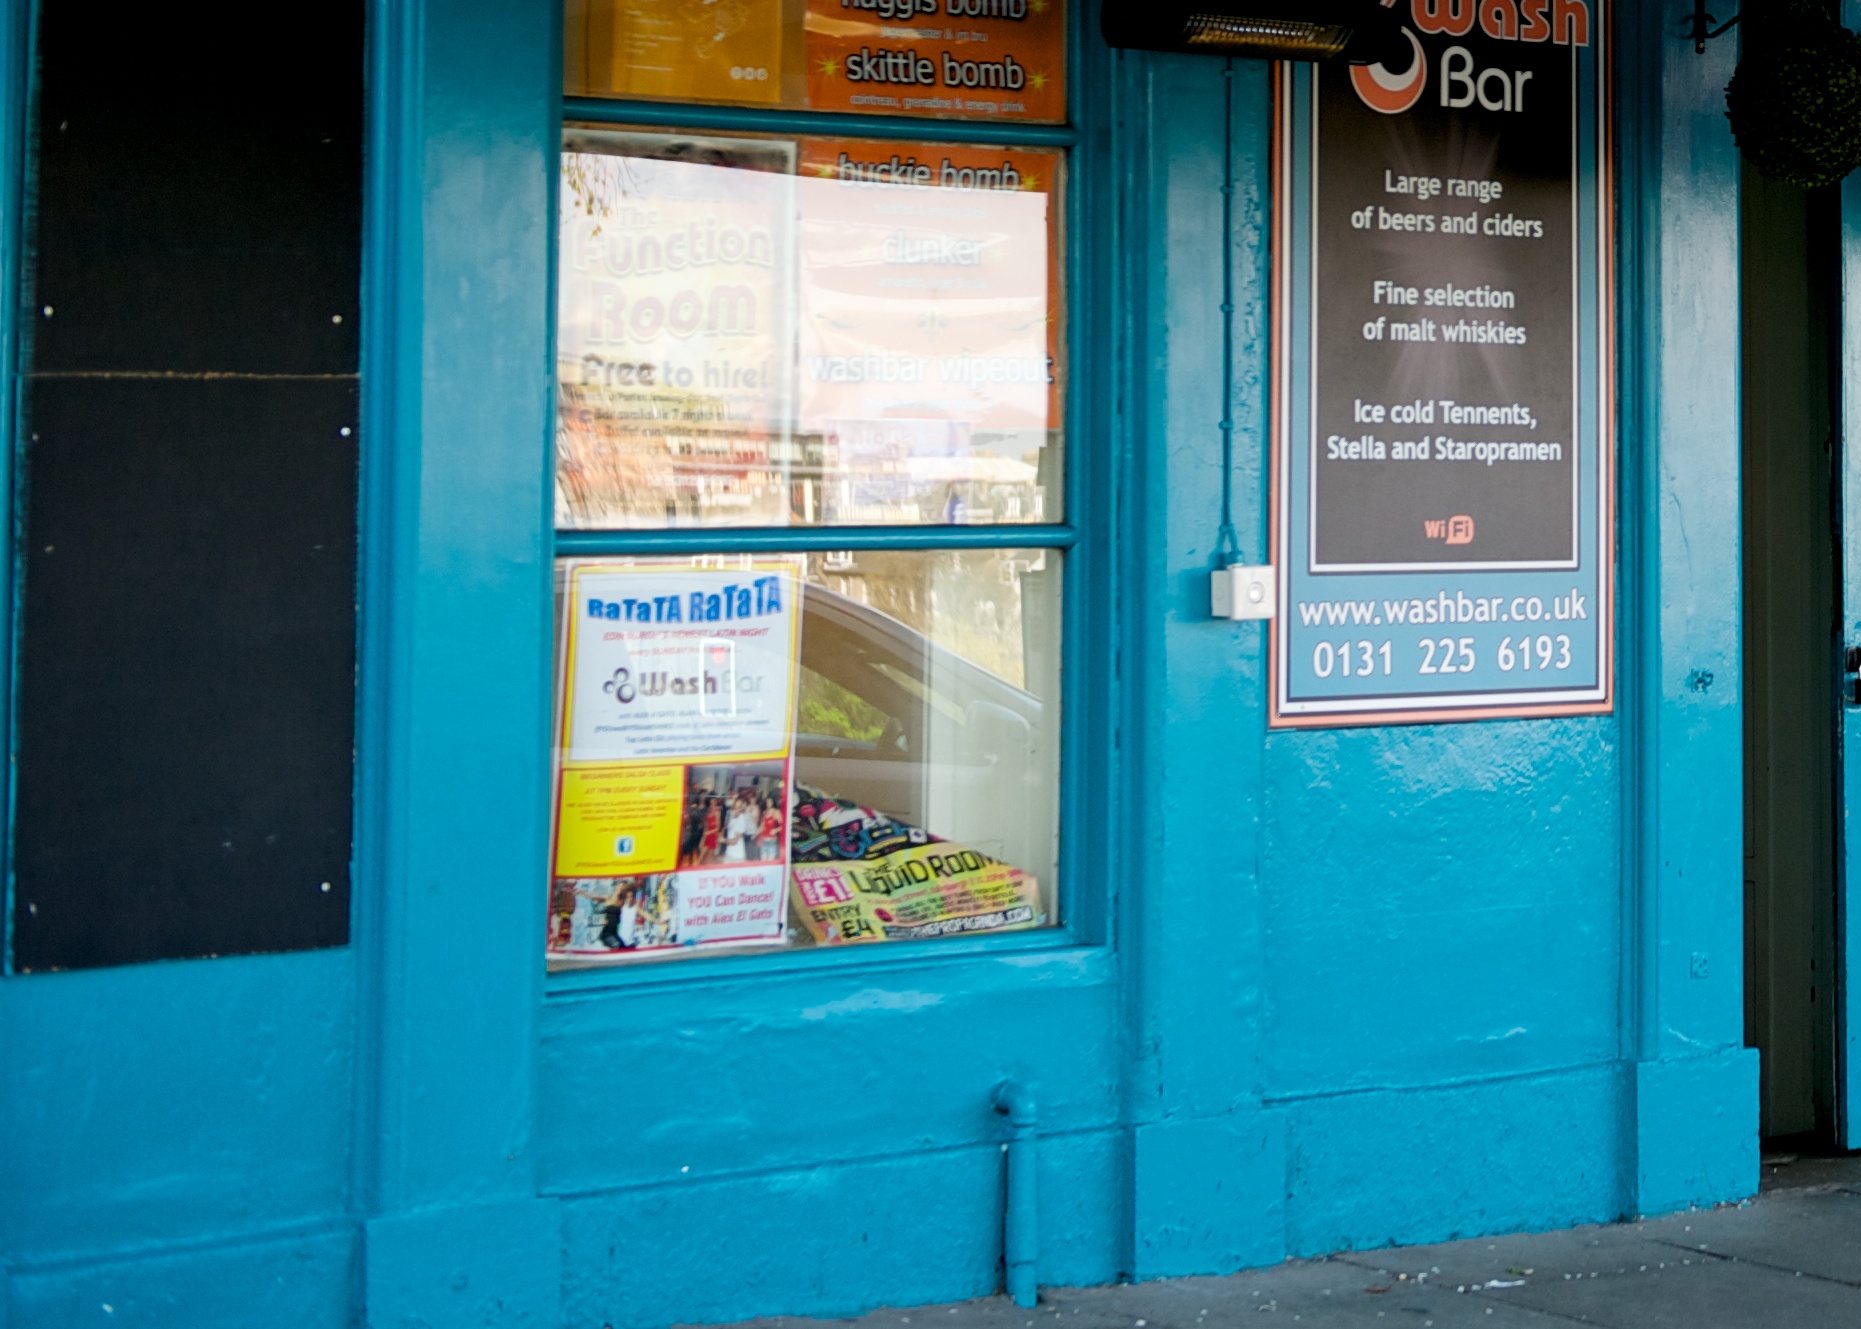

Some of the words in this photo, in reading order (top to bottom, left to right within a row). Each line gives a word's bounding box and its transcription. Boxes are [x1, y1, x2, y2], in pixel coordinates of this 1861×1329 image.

[846, 47, 935, 86] skittle
[942, 51, 1026, 91] bomb
[1440, 45, 1533, 112] Bar
[838, 153, 930, 191] buckie
[939, 157, 1020, 194] bomb
[1385, 170, 1442, 200] Large
[1447, 177, 1503, 203] range
[617, 206, 660, 229] The
[1351, 206, 1375, 230] of
[1378, 207, 1435, 233] beers
[1440, 211, 1478, 235] and
[1482, 213, 1544, 238] ciders
[881, 229, 985, 267] clunker
[1373, 280, 1419, 305] Fine
[1423, 283, 1515, 309] selection
[1362, 318, 1386, 341] of
[1390, 319, 1437, 342] malt
[1441, 321, 1527, 345] whiskies
[580, 353, 657, 387] Free
[663, 360, 694, 389] to
[702, 359, 769, 389] hire!
[807, 350, 928, 386] washbar
[939, 349, 1056, 392] wipeout
[1354, 399, 1386, 423] Ice
[1390, 400, 1435, 424] cold
[1438, 400, 1537, 430] Tennents,
[1327, 435, 1387, 460] Stella
[1391, 436, 1430, 460] and
[1434, 436, 1562, 466] Staropramen
[1299, 587, 1588, 628] www.washbar.co.uk
[1312, 639, 1394, 679] 0131
[1417, 637, 1477, 675] 225
[1497, 634, 1573, 672] 6193
[639, 669, 717, 697] Wash
[721, 671, 765, 694] Bar
